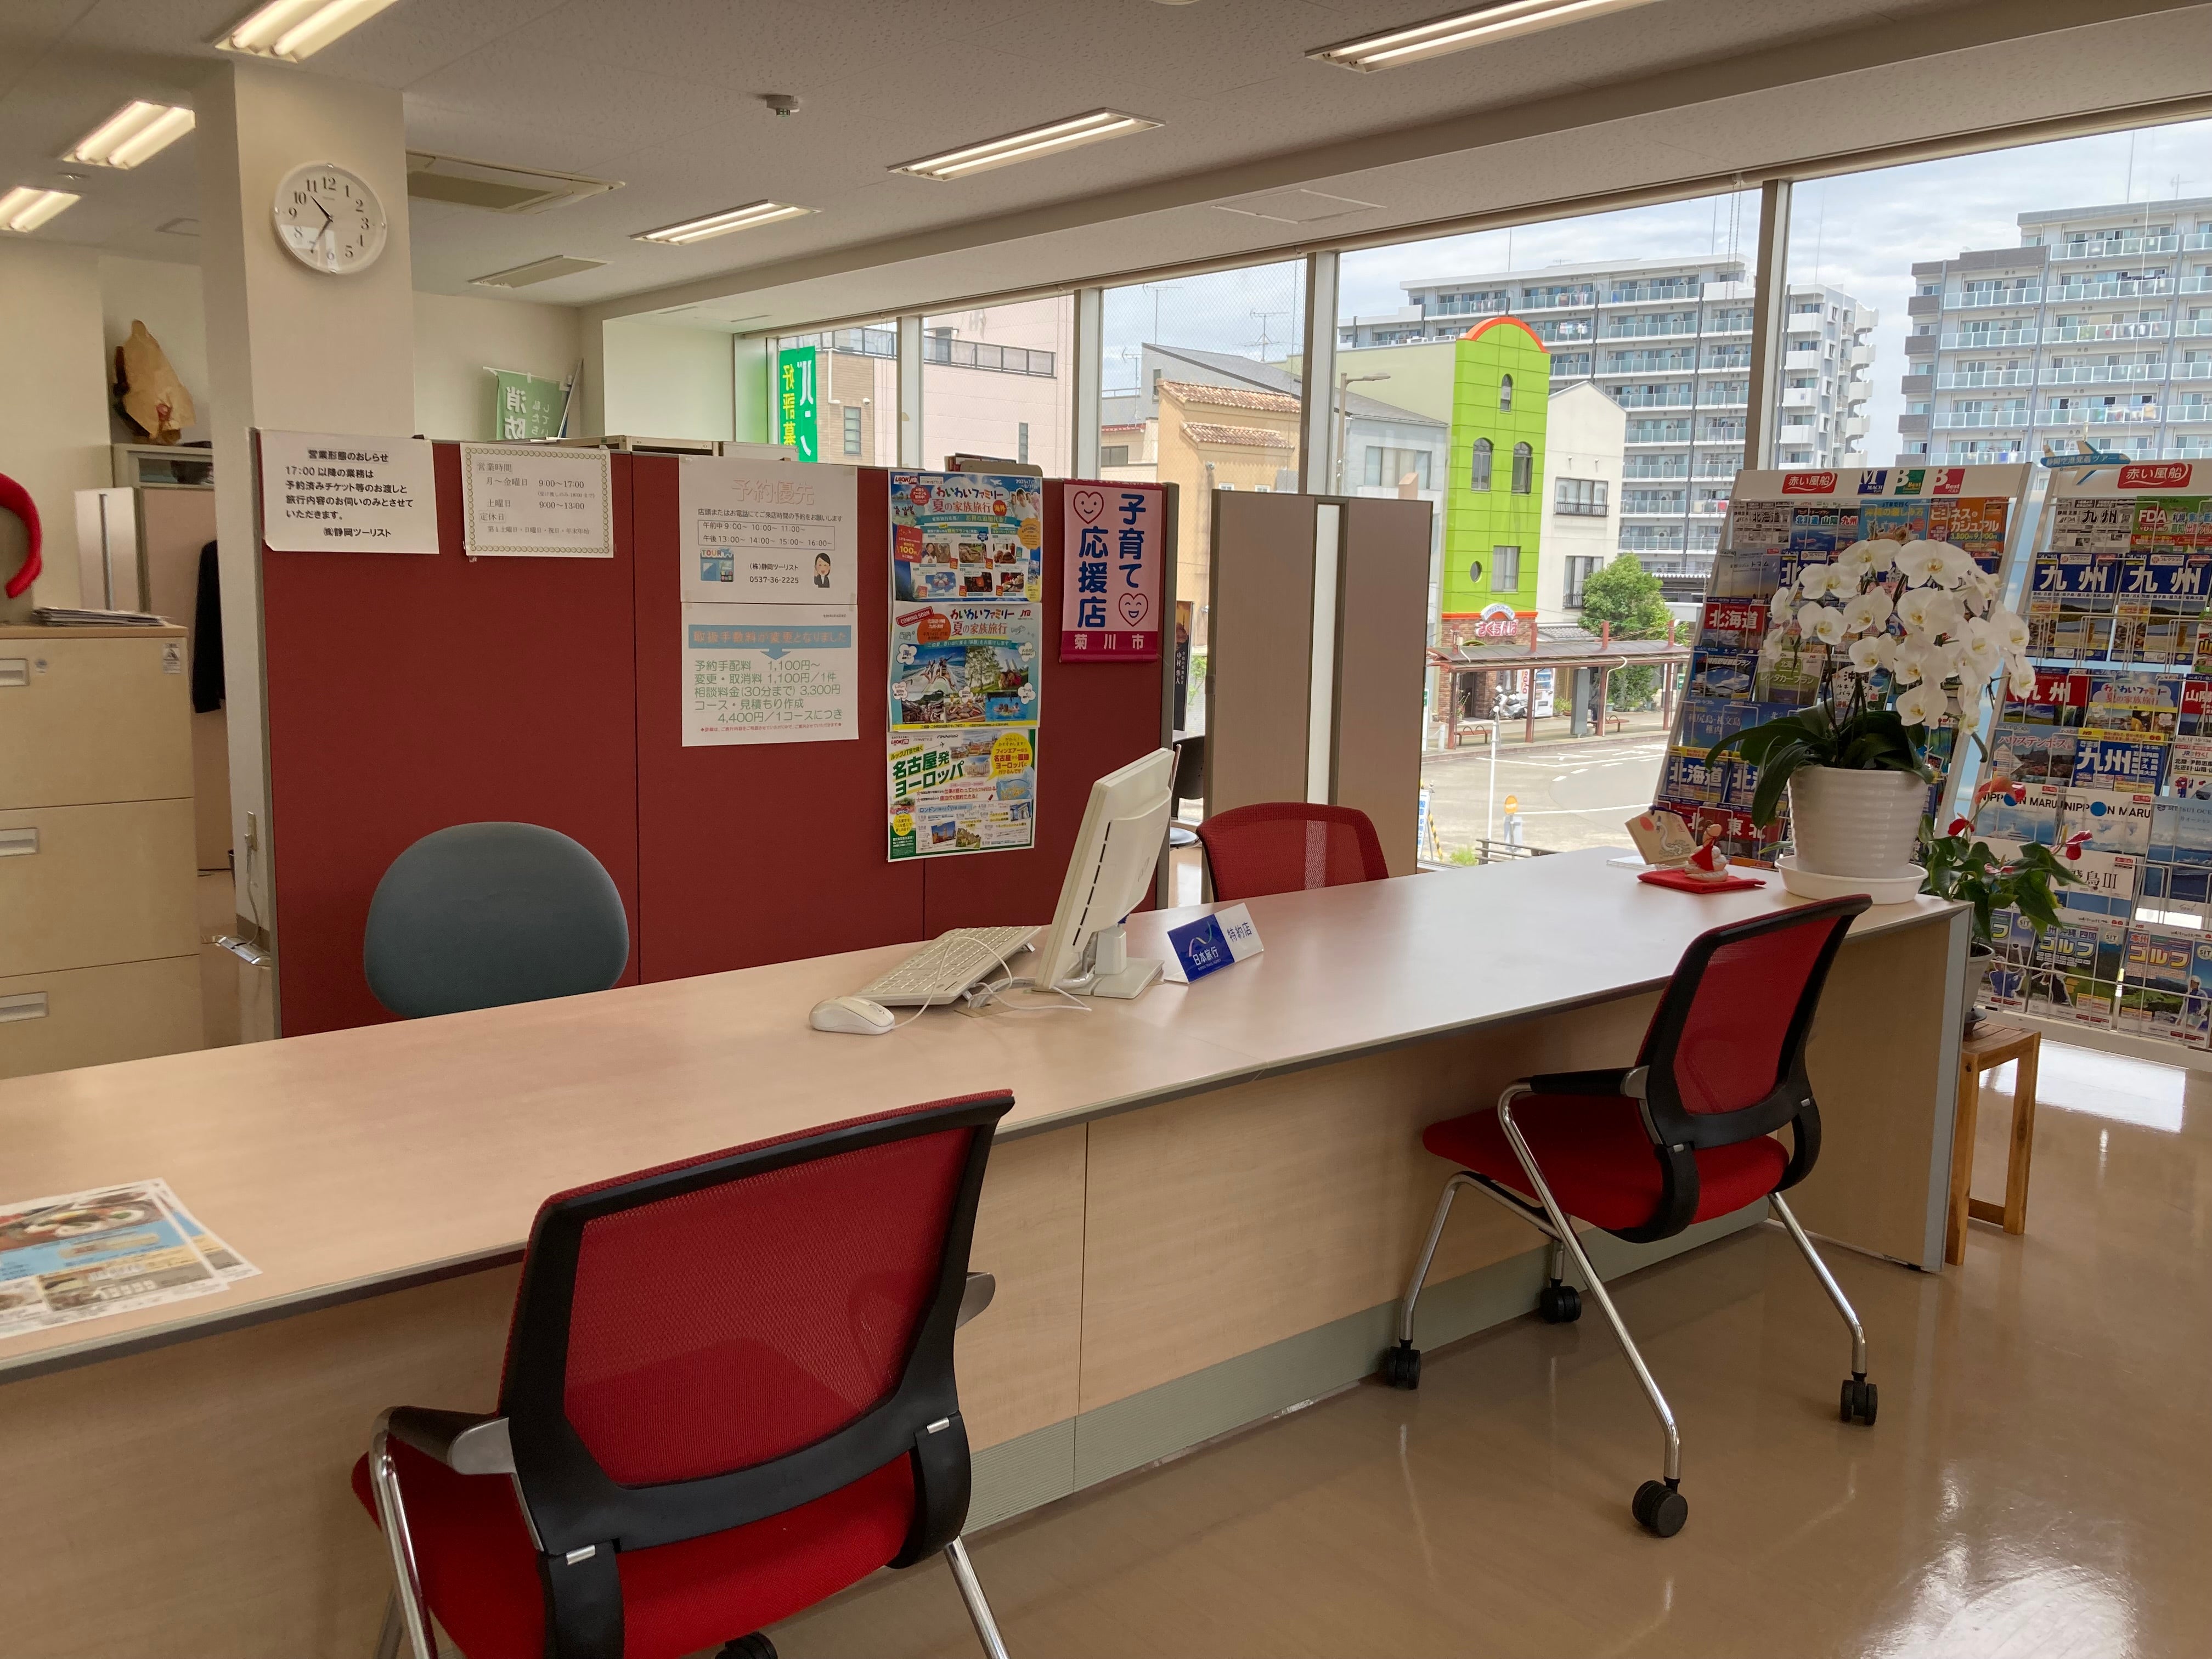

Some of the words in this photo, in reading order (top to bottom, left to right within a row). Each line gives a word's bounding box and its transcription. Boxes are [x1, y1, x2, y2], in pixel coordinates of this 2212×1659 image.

[307, 179, 318, 193] 11
[323, 176, 336, 191] 12
[294, 190, 307, 205] 10
[345, 184, 351, 198] 1
[356, 199, 364, 213] 2
[288, 207, 297, 220] 9
[360, 217, 370, 230] 3
[345, 245, 353, 258] 5
[308, 449, 388, 462] 営業形態のおしらせ
[285, 466, 315, 476] 17:00
[318, 467, 374, 478] 以降の業務は
[478, 462, 512, 472] 営業時間
[2126, 467, 2182, 479] 赤い風船
[285, 480, 407, 493] 予約済みチケット等のお渡しと
[1788, 475, 1831, 486] 赤い風船
[732, 478, 815, 506] 予約優先
[936, 487, 1003, 499] わいわいファミリー
[286, 495, 414, 507] 旅行内容のお伺いのみとさせて
[487, 499, 511, 507] 土曜日
[933, 499, 991, 513] 夏の家族旅行
[286, 510, 343, 520] いただきます。
[480, 513, 505, 521] 定休日
[1752, 510, 1780, 523] 北海道
[1841, 515, 1858, 526] 九州
[1931, 508, 1972, 521] ビジネス
[2080, 509, 2118, 525] 九州
[2138, 509, 2167, 523] FDA
[703, 522, 723, 530] 午前中
[1951, 520, 1999, 532] カジュアル
[1119, 493, 1146, 588] 子育て
[1077, 526, 1109, 628] 応援店
[2039, 566, 2108, 592] 九州
[2128, 566, 2202, 594] 九州
[900, 614, 918, 624] COMING
[918, 609, 930, 619] SOON
[950, 608, 1014, 620] わいわいファミリー
[1709, 610, 1758, 629] 北海道
[951, 621, 1008, 636] 夏の家族旅行
[1476, 619, 1519, 636] さくらんぼ
[1074, 633, 1144, 650] 菊川市
[695, 661, 751, 672] 予約手配料
[695, 674, 763, 685] 変更・取消料
[1760, 674, 1815, 685] レンタカープラン
[695, 686, 796, 698] 相談料金(30分まで)
[800, 684, 840, 696] 3,300円
[695, 698, 804, 710] コース・見積もり作成
[892, 751, 950, 780] 名古屋発
[2076, 747, 2131, 774] 九州
[895, 760, 964, 798] ヨーロッパ
[1669, 763, 1723, 787] 北海道
[2029, 797, 2057, 809] MARU
[2118, 806, 2152, 819] MARU
[1227, 922, 1253, 943] 特約店
[2039, 936, 2095, 957] ゴルフ
[1192, 946, 1219, 966] 日本旅行
[2129, 945, 2191, 969] ゴルフ
